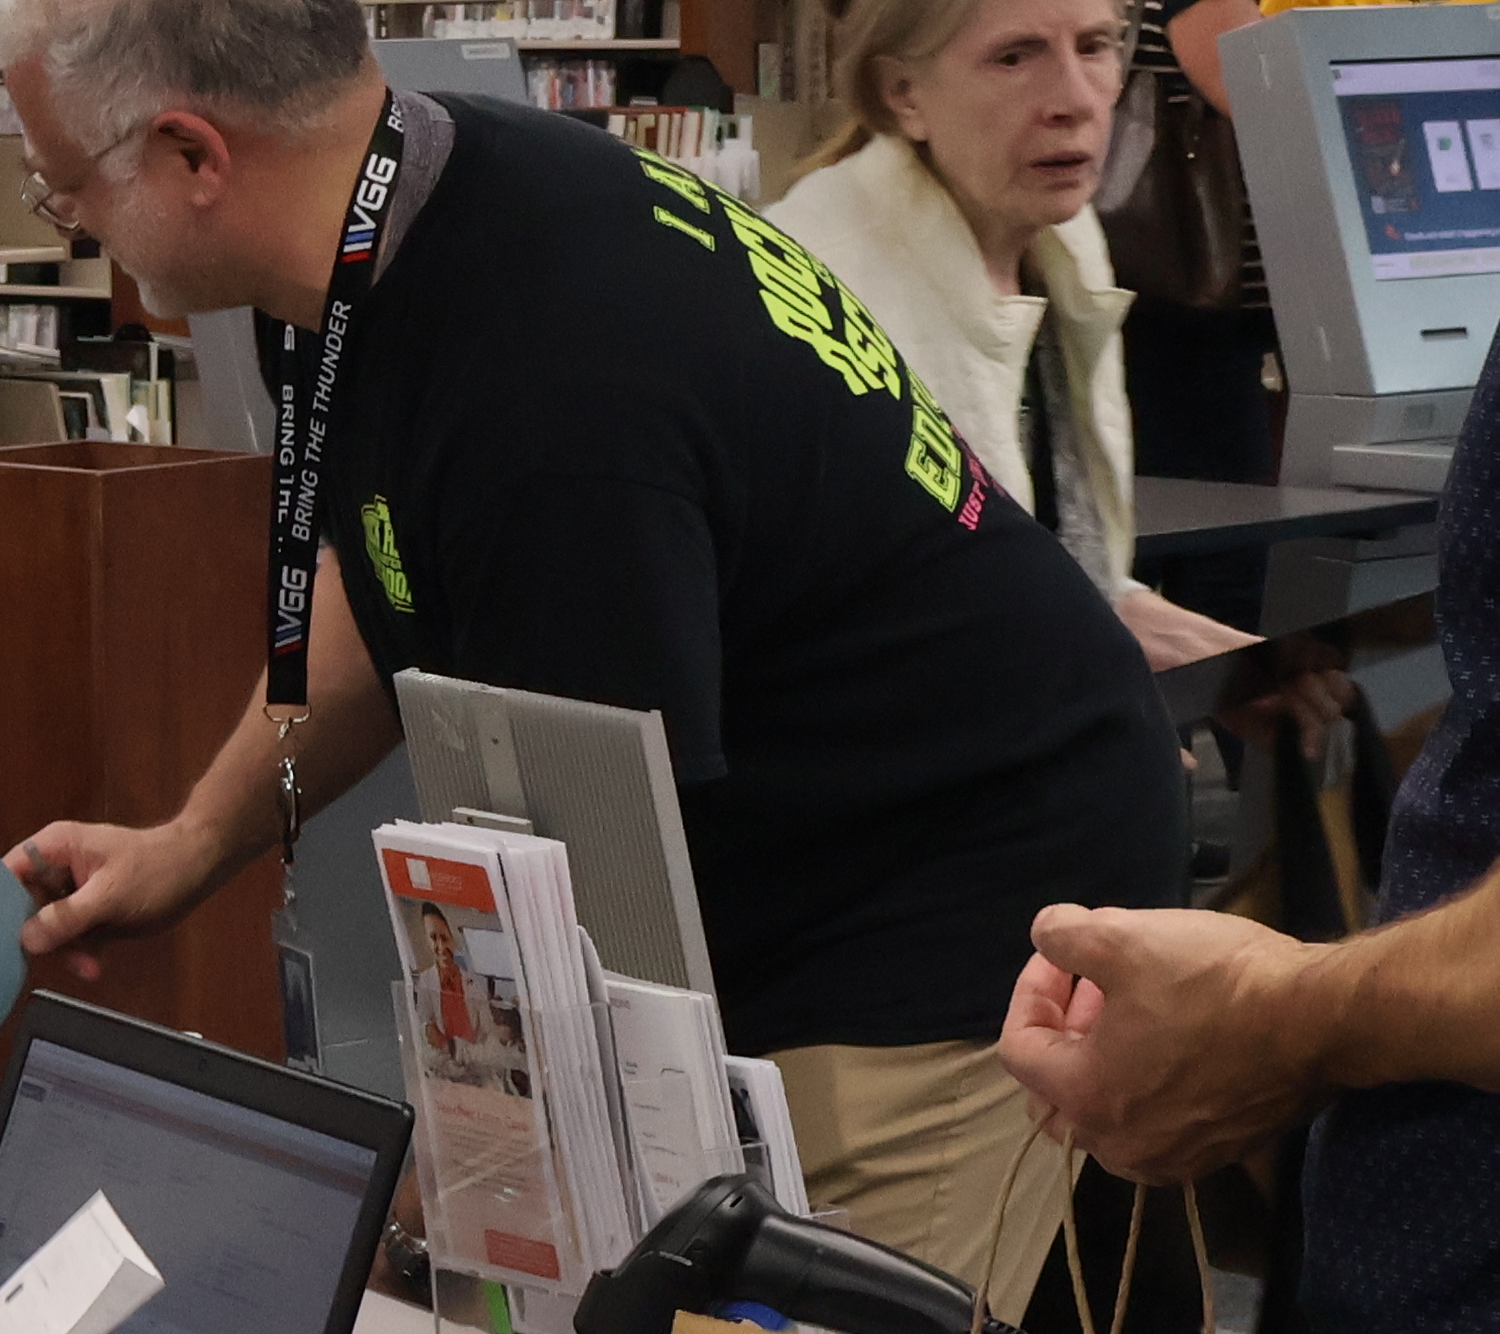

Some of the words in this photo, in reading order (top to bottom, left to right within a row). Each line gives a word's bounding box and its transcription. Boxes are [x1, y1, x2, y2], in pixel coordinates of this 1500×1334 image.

[714, 194, 886, 397] ROCK
[311, 299, 353, 413] THUNDER
[280, 384, 296, 467] BRING
[304, 416, 327, 465] THE
[290, 469, 319, 542] BRING
[957, 480, 988, 532] JUST
